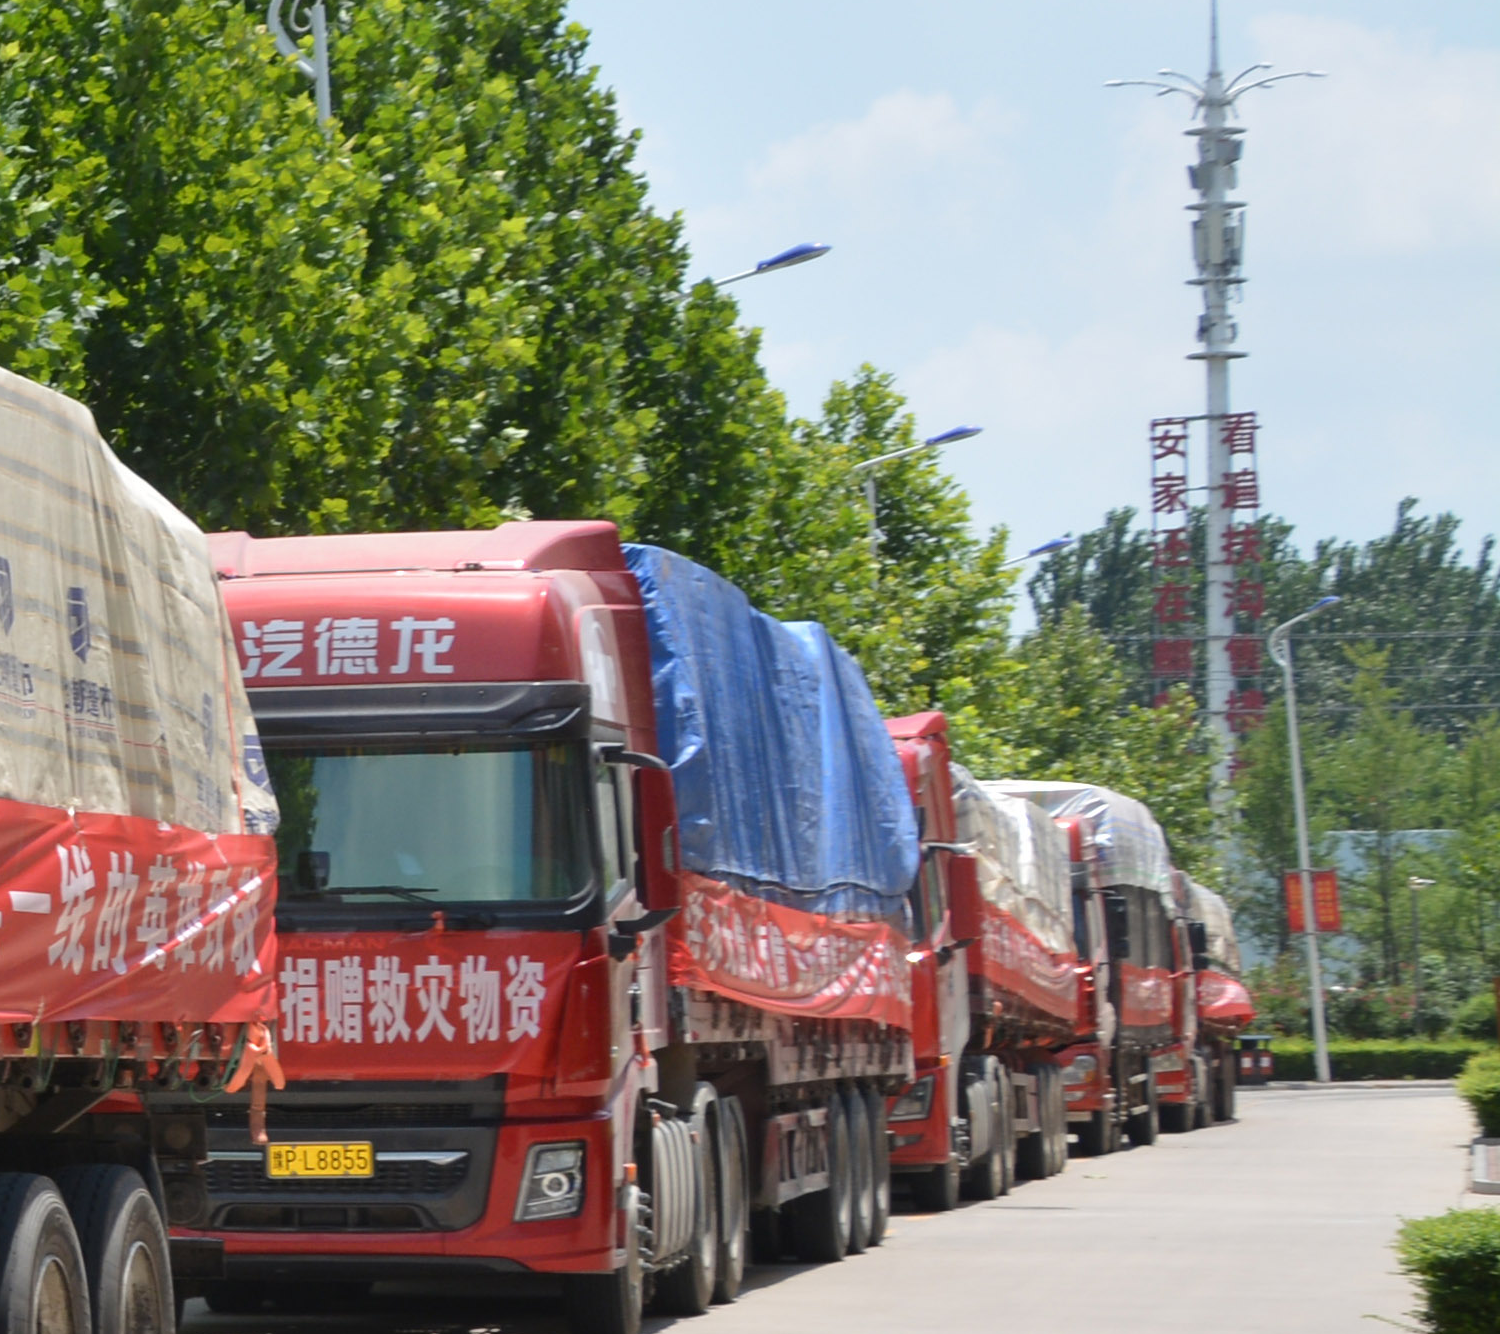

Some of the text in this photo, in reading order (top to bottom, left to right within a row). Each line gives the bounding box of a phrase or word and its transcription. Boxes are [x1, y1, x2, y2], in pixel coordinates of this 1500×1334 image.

[280, 954, 547, 1044] 捐赠救灾物资
